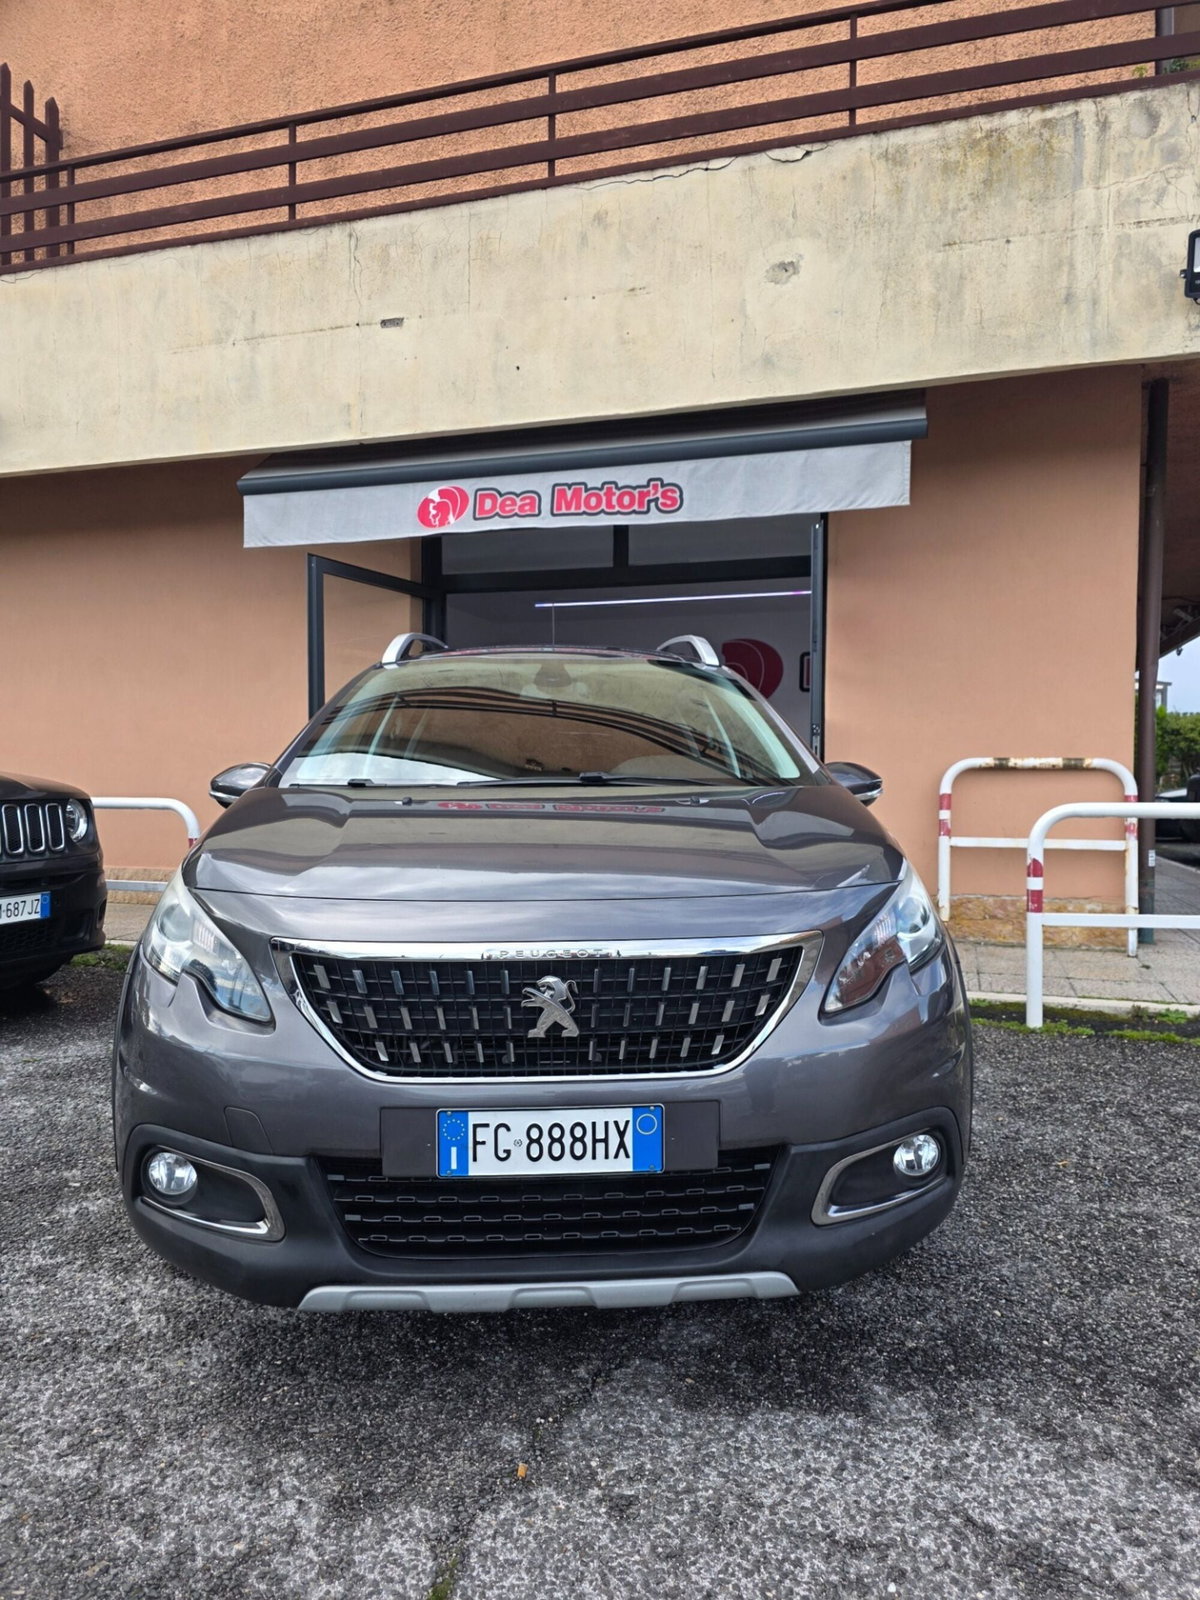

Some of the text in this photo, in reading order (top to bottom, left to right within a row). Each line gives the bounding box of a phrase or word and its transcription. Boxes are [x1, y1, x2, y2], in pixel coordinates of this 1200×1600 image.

[474, 479, 682, 519] Dea Motor's
[499, 949, 604, 959] PEUGEOT
[526, 1120, 631, 1162] 888HX
